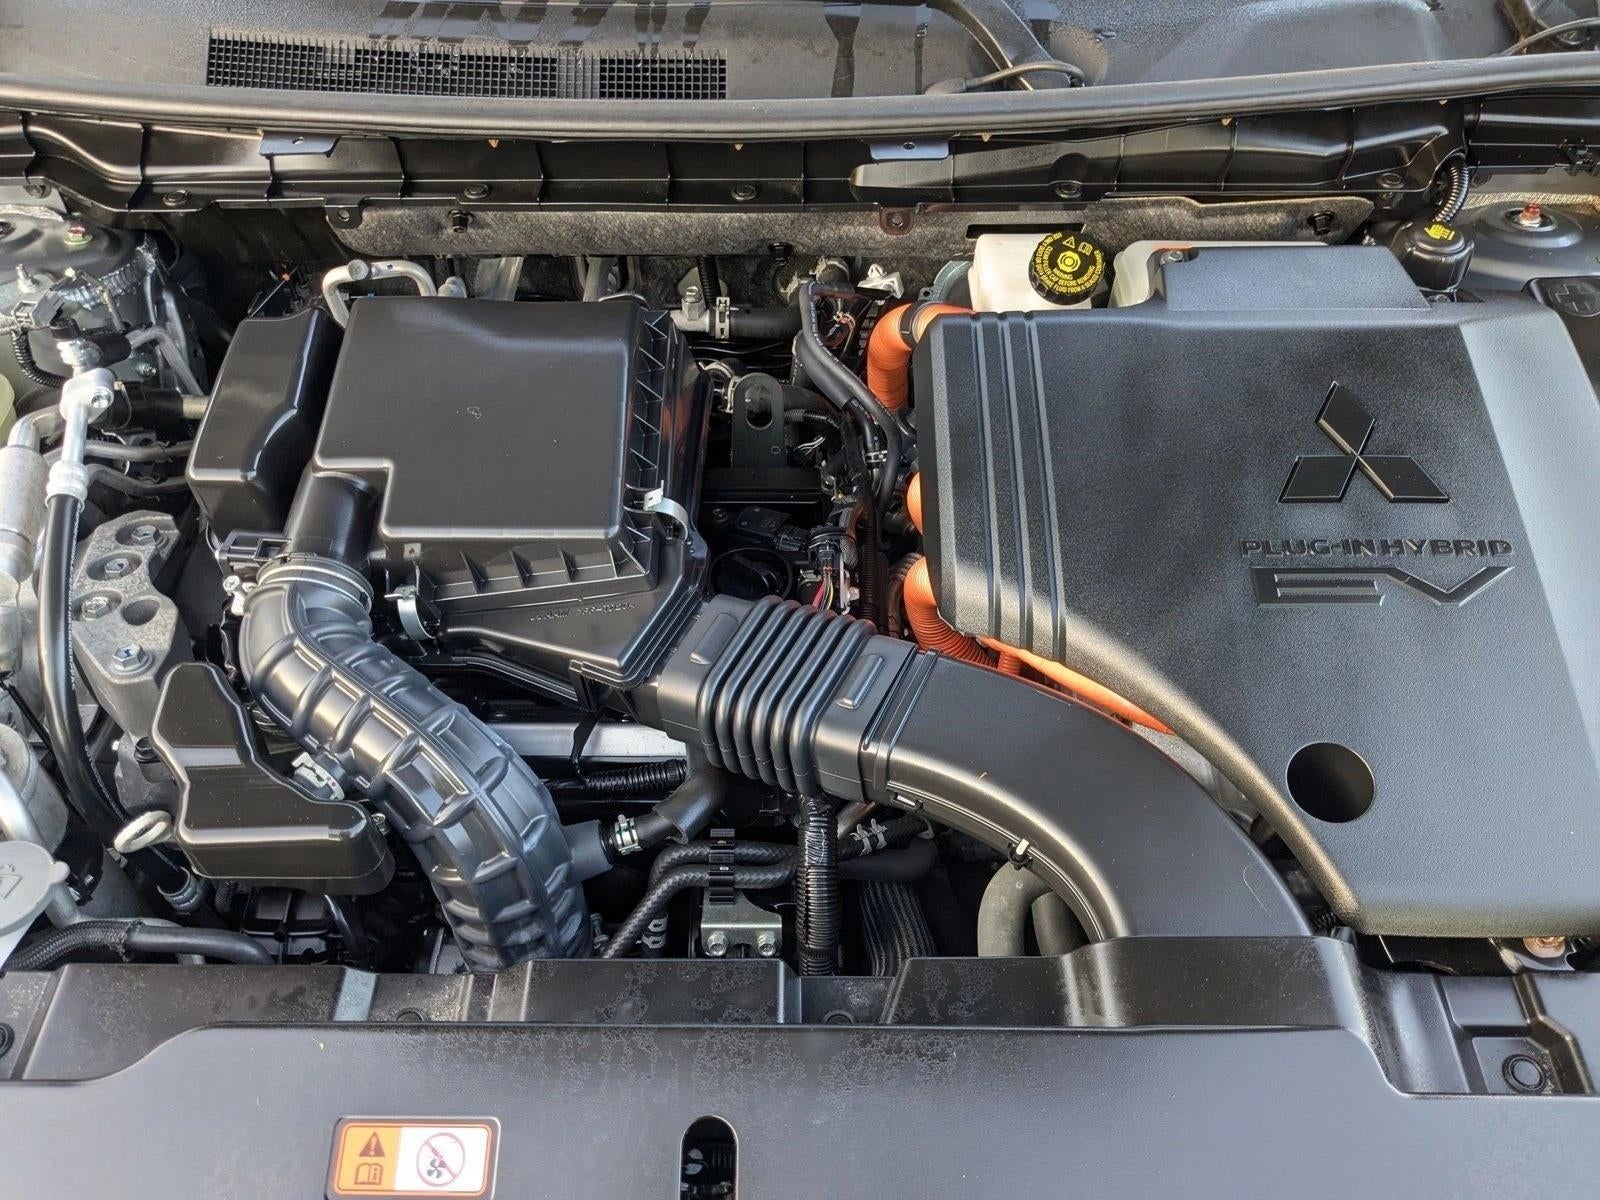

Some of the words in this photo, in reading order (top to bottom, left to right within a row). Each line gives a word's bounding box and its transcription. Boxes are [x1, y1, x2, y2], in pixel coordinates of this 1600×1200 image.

[1240, 539, 1376, 557] PLUG-IN
[1380, 539, 1513, 558] HYBRID
[1252, 565, 1516, 608] EV
